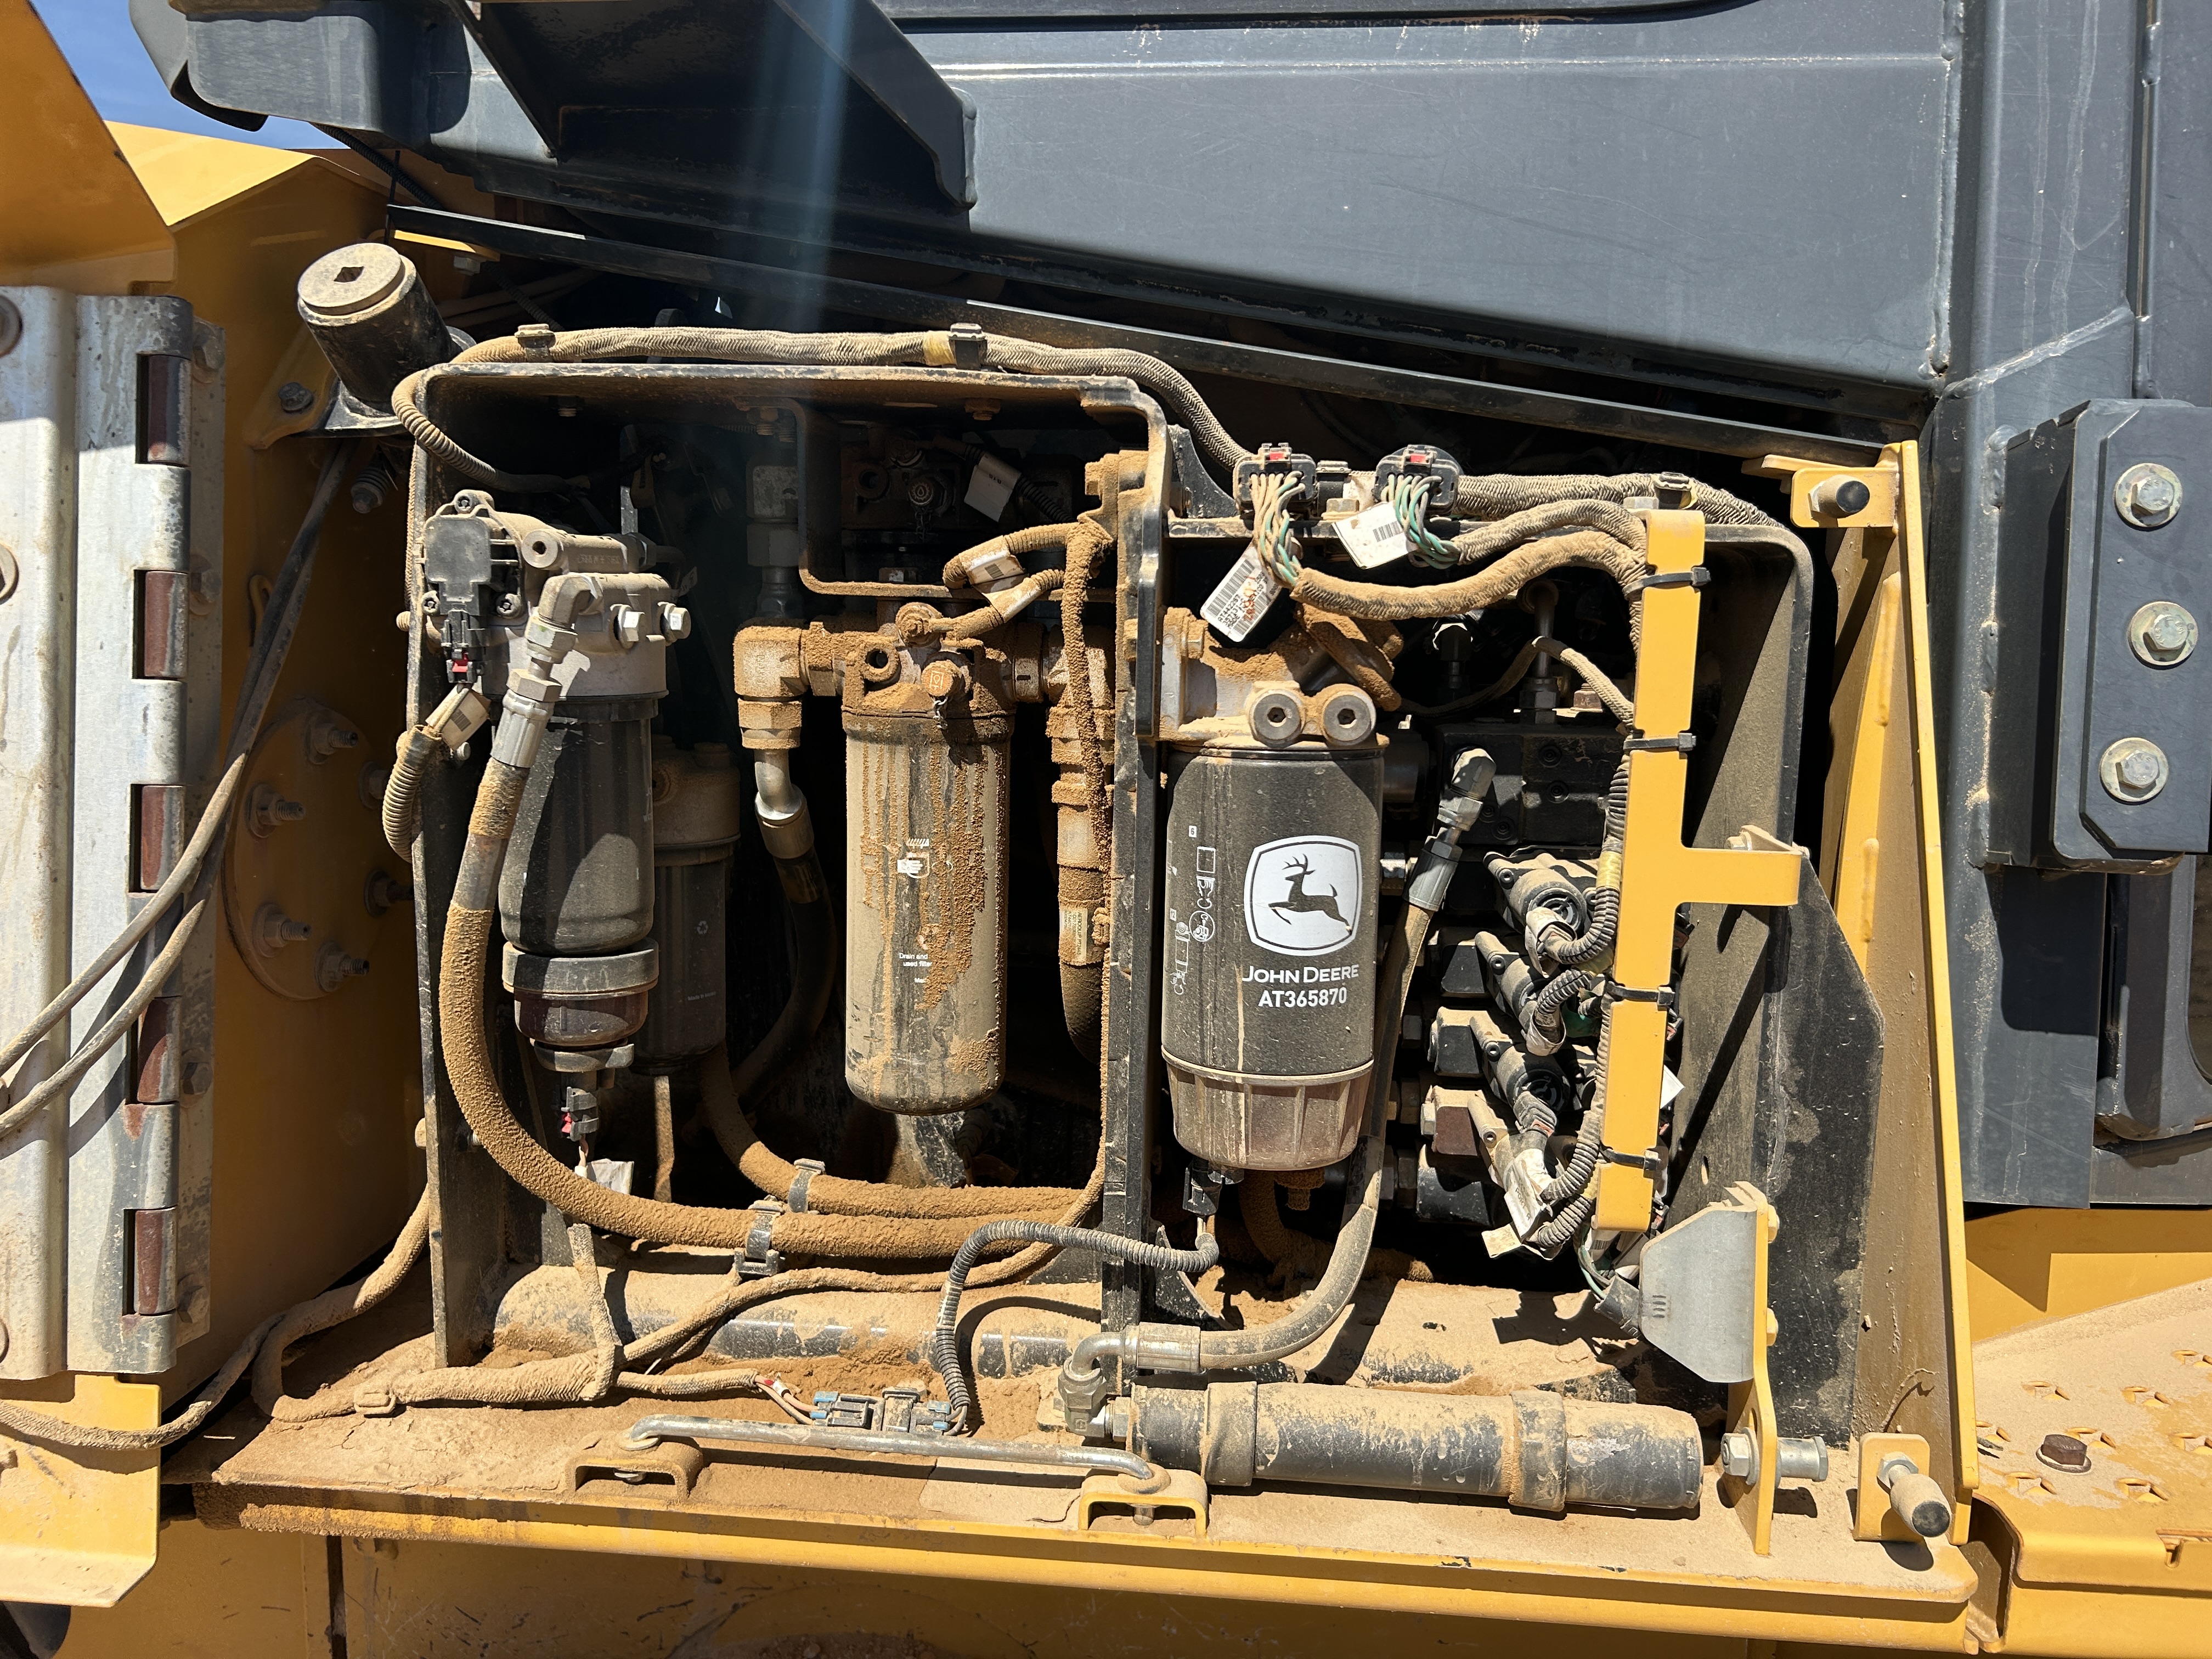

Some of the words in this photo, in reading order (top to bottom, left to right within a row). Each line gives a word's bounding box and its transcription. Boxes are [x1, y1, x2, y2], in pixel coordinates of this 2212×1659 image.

[1190, 827, 1195, 836] 6
[1242, 966, 1300, 984] JOHN
[1303, 964, 1359, 983] DEERE
[1258, 986, 1348, 1008] AT365870
